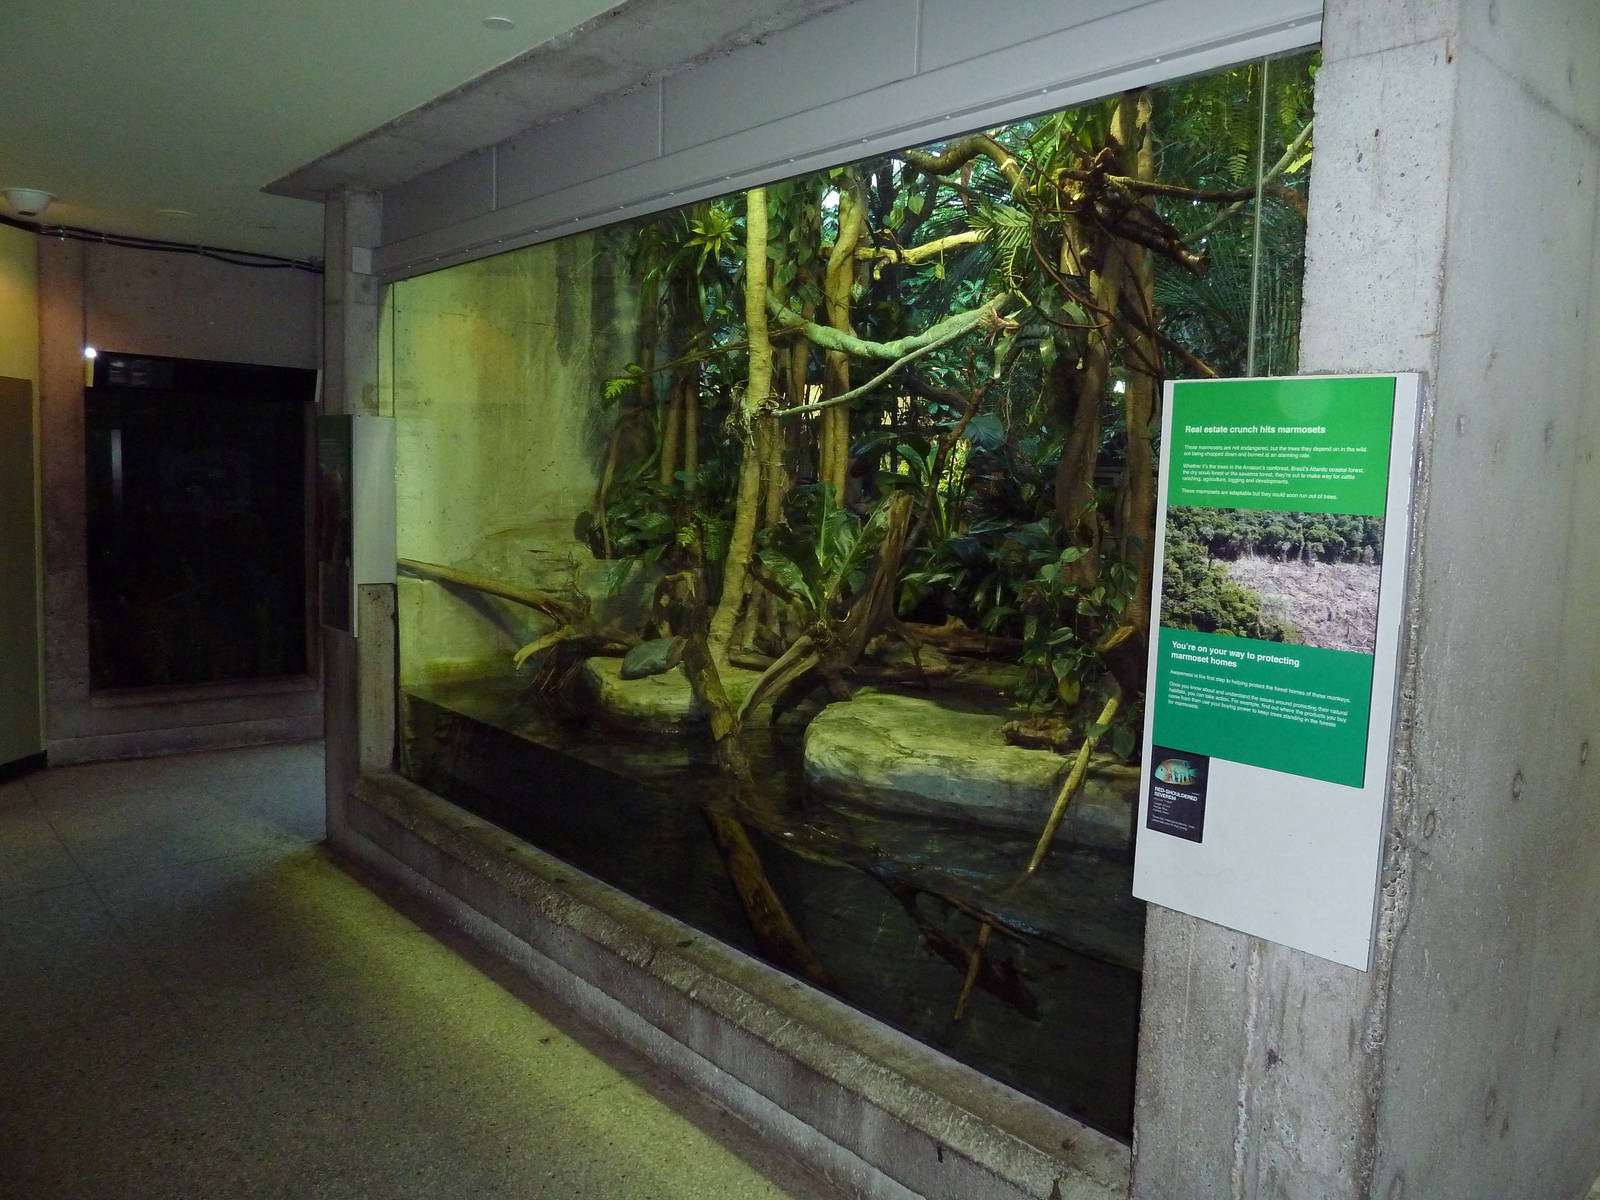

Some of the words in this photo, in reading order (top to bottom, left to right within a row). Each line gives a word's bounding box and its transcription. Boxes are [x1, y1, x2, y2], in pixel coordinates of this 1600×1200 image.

[1278, 426, 1326, 434] marmosets
[1171, 652, 1208, 663] marmoset
[1210, 656, 1237, 667] homes
[1172, 640, 1196, 651] You're
[1209, 647, 1227, 655] your
[1229, 650, 1245, 660] way
[1247, 651, 1255, 659] to
[1257, 654, 1300, 668] protecting
[1232, 678, 1248, 687] helping
[1289, 687, 1305, 695] homes
[1221, 702, 1236, 711] buying
[1257, 709, 1269, 717] keep
[1283, 713, 1304, 722] standing
[1293, 703, 1317, 711] protecting
[1304, 711, 1325, 719] products
